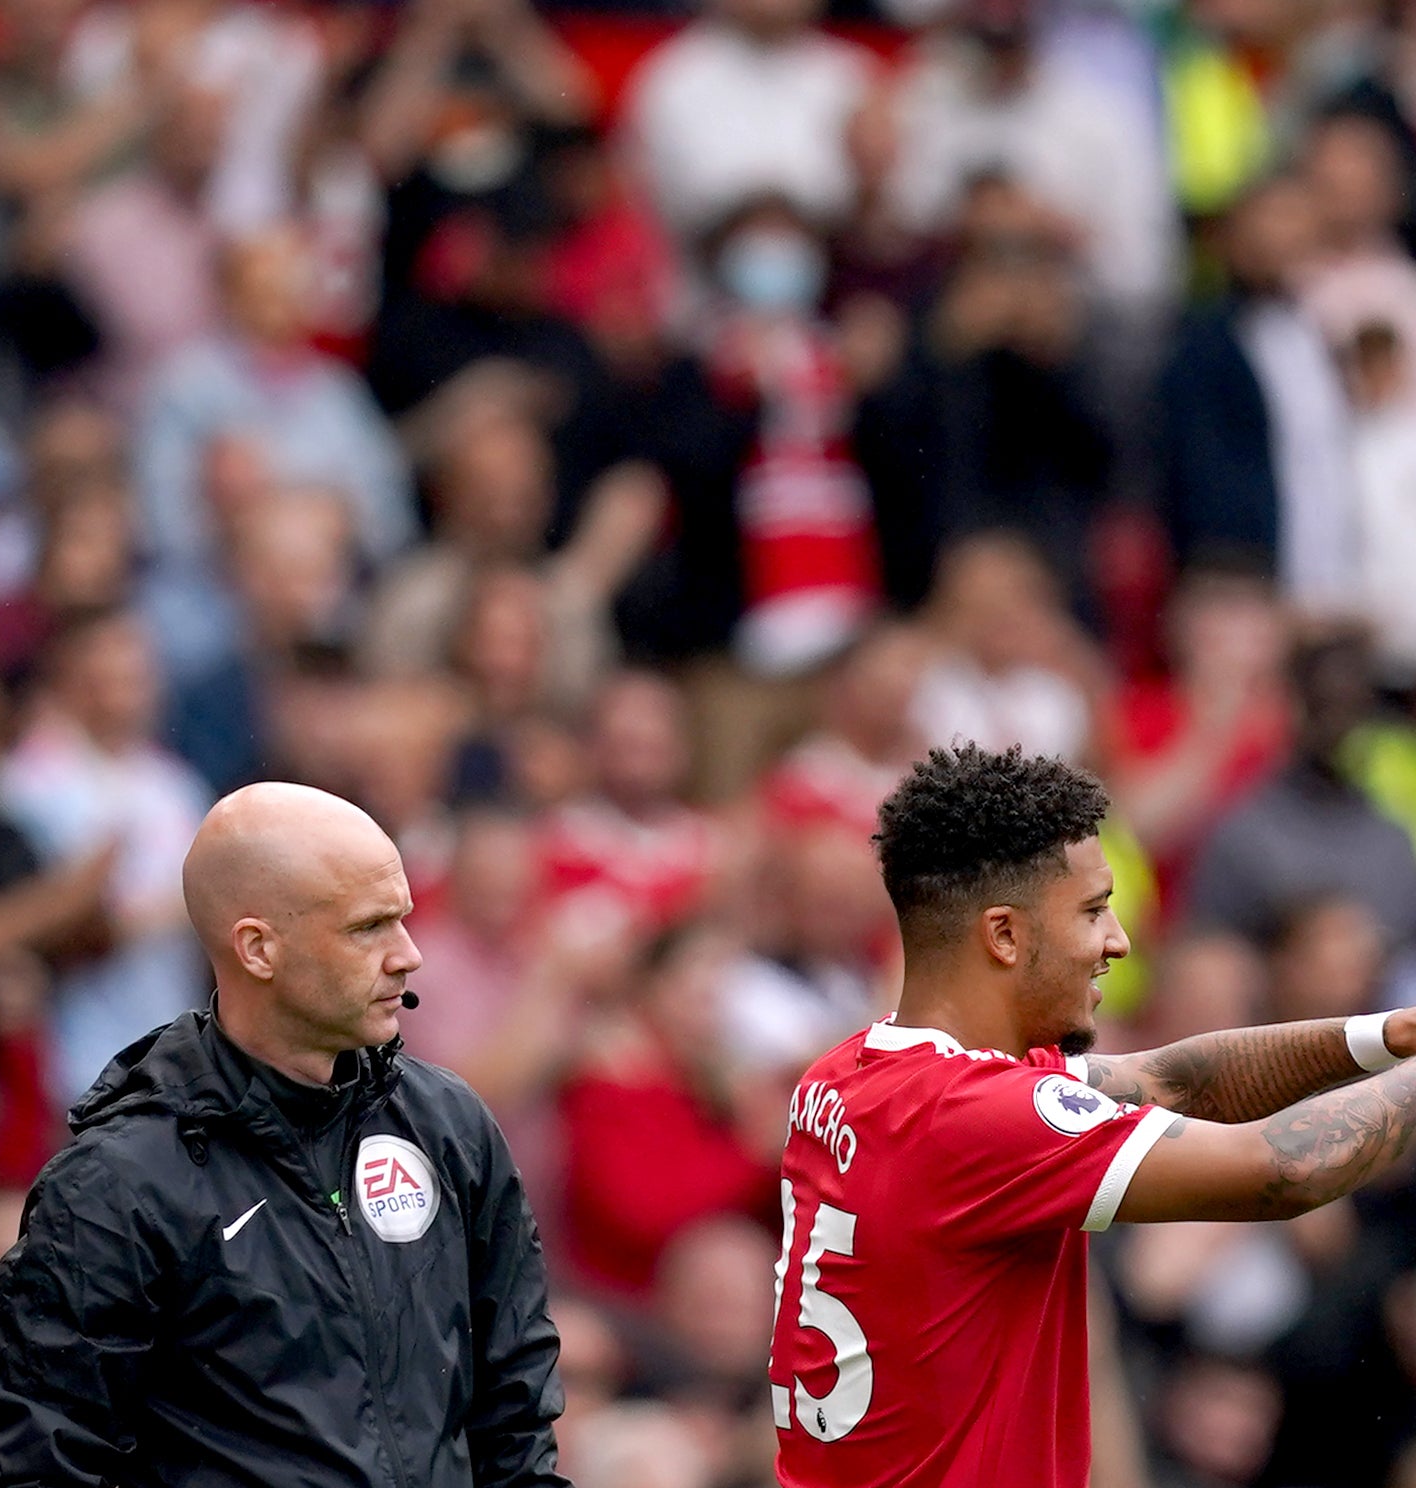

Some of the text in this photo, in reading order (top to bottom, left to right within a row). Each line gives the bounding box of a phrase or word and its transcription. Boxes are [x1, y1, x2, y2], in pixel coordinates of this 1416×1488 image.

[784, 1081, 857, 1174] ANCHO
[363, 1157, 421, 1200] EA
[368, 1191, 426, 1218] SPORTS
